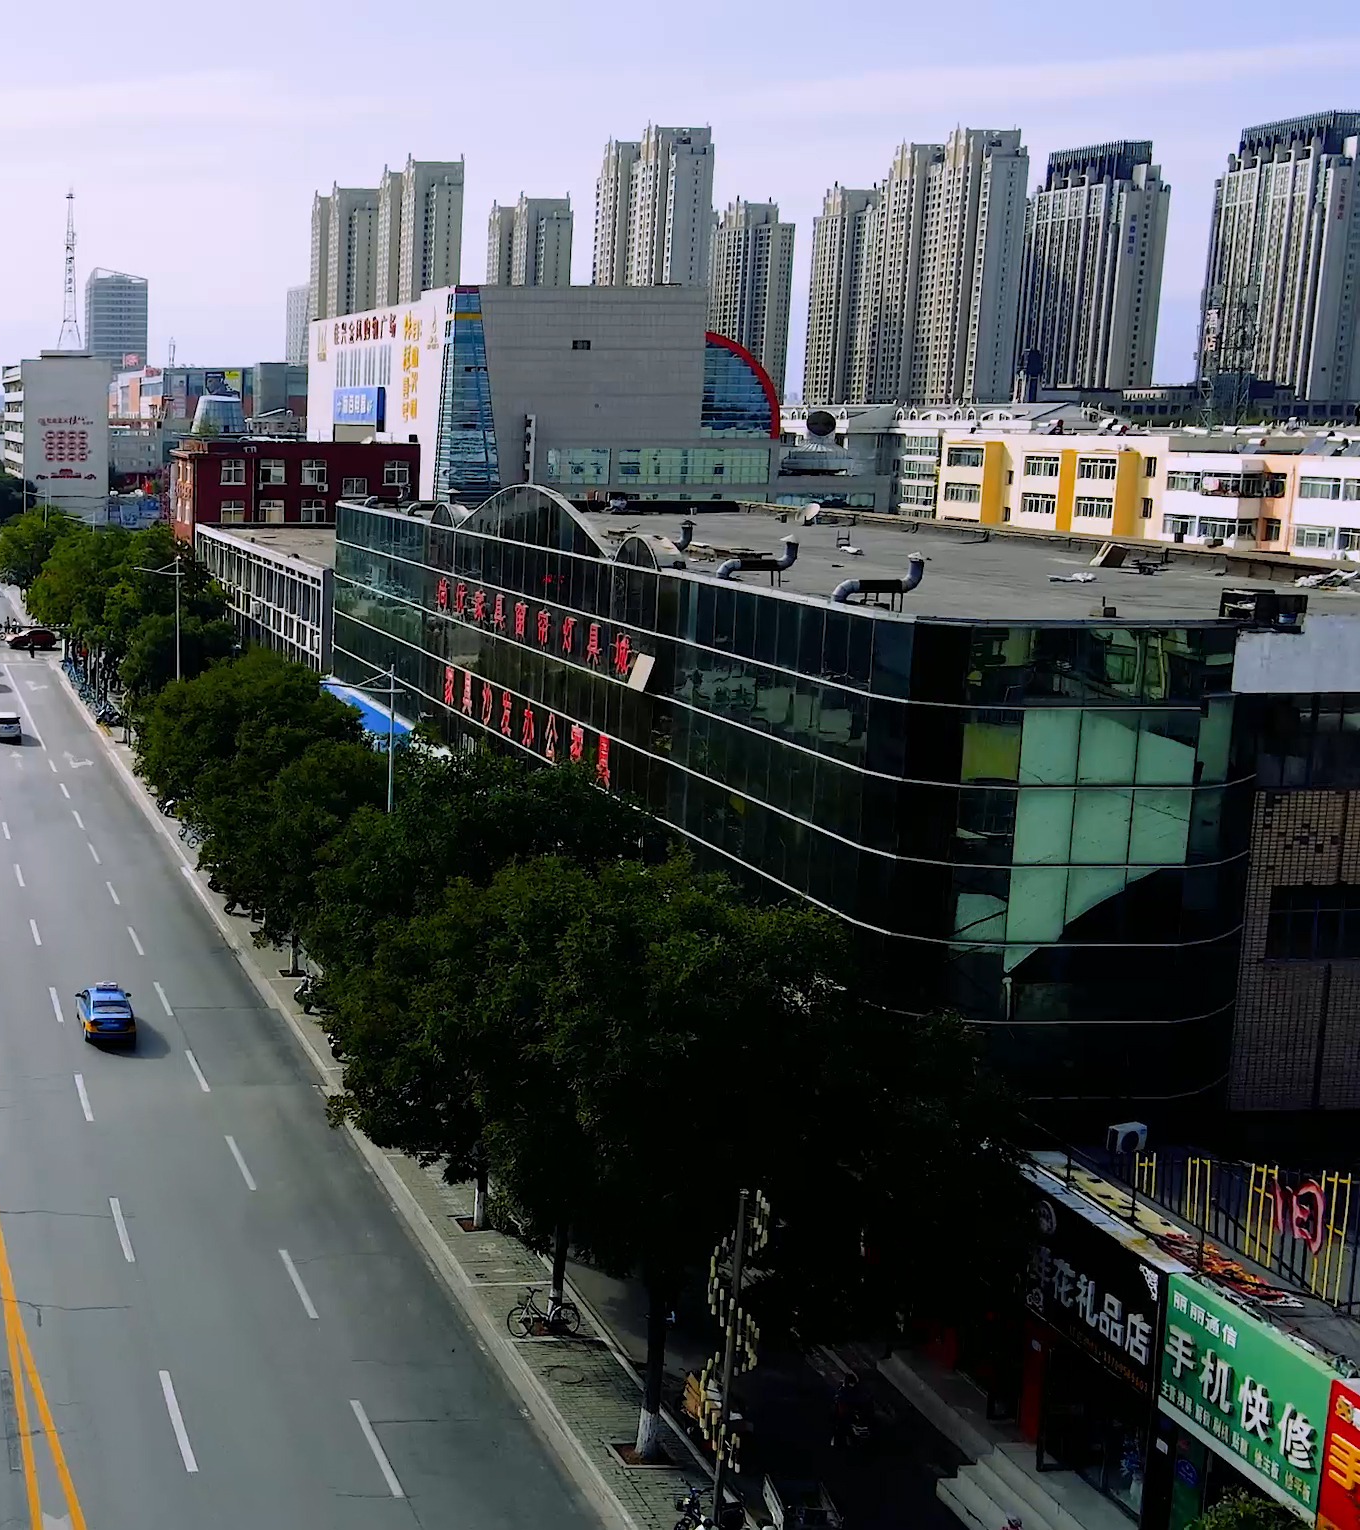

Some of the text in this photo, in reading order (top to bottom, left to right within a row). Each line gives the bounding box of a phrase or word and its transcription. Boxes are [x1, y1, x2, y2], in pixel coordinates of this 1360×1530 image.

[1172, 1289, 1239, 1350] 丽丽通信
[1164, 1323, 1318, 1471] 手机快修
